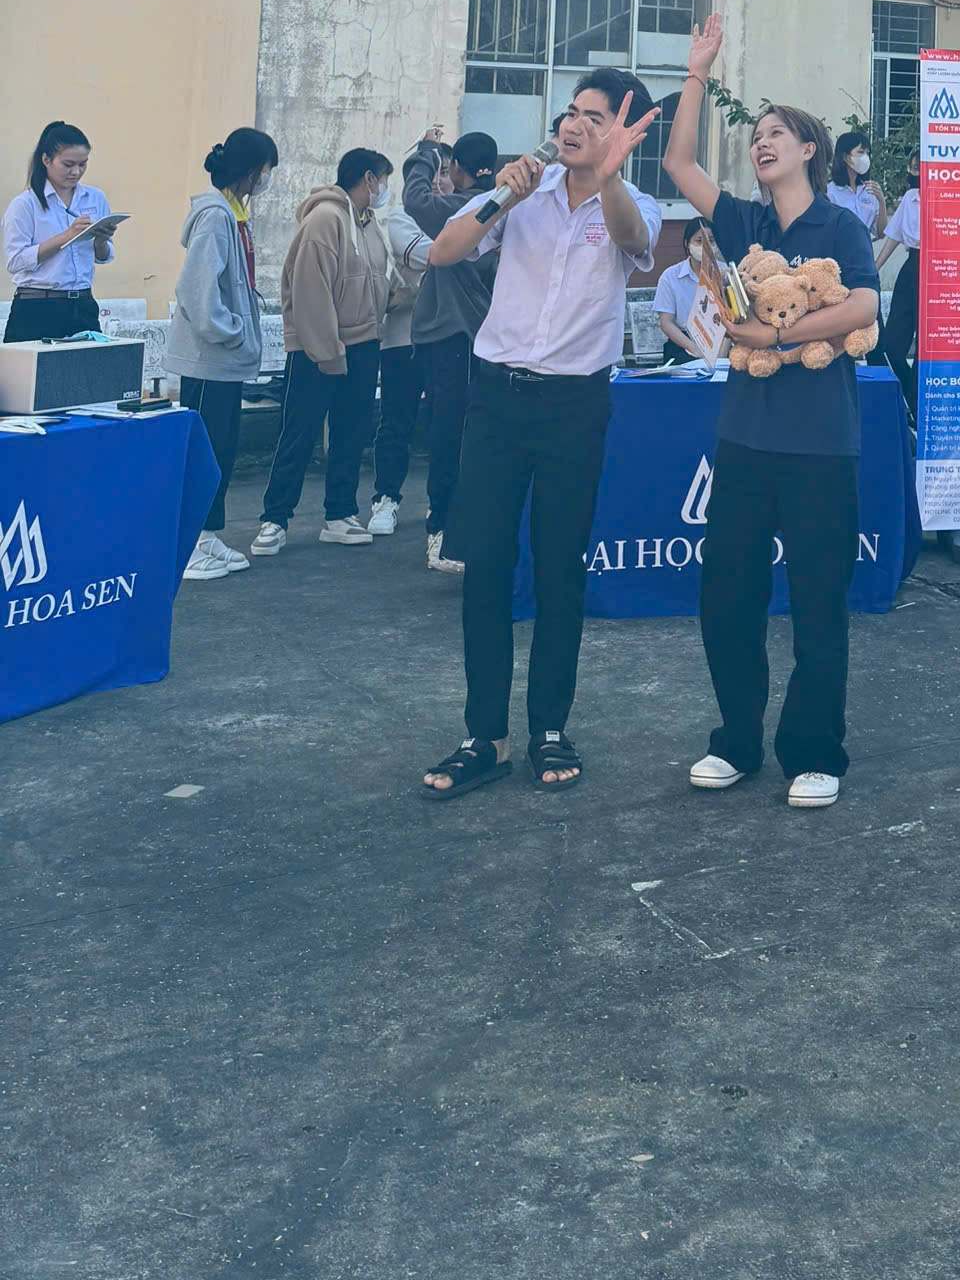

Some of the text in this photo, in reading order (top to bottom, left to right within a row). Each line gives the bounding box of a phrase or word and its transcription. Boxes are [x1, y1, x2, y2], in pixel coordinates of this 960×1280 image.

[926, 377, 948, 388] HỌC
[925, 466, 954, 474] TRUNG
[582, 540, 627, 576] ẠI
[4, 572, 138, 628] HOA SEN
